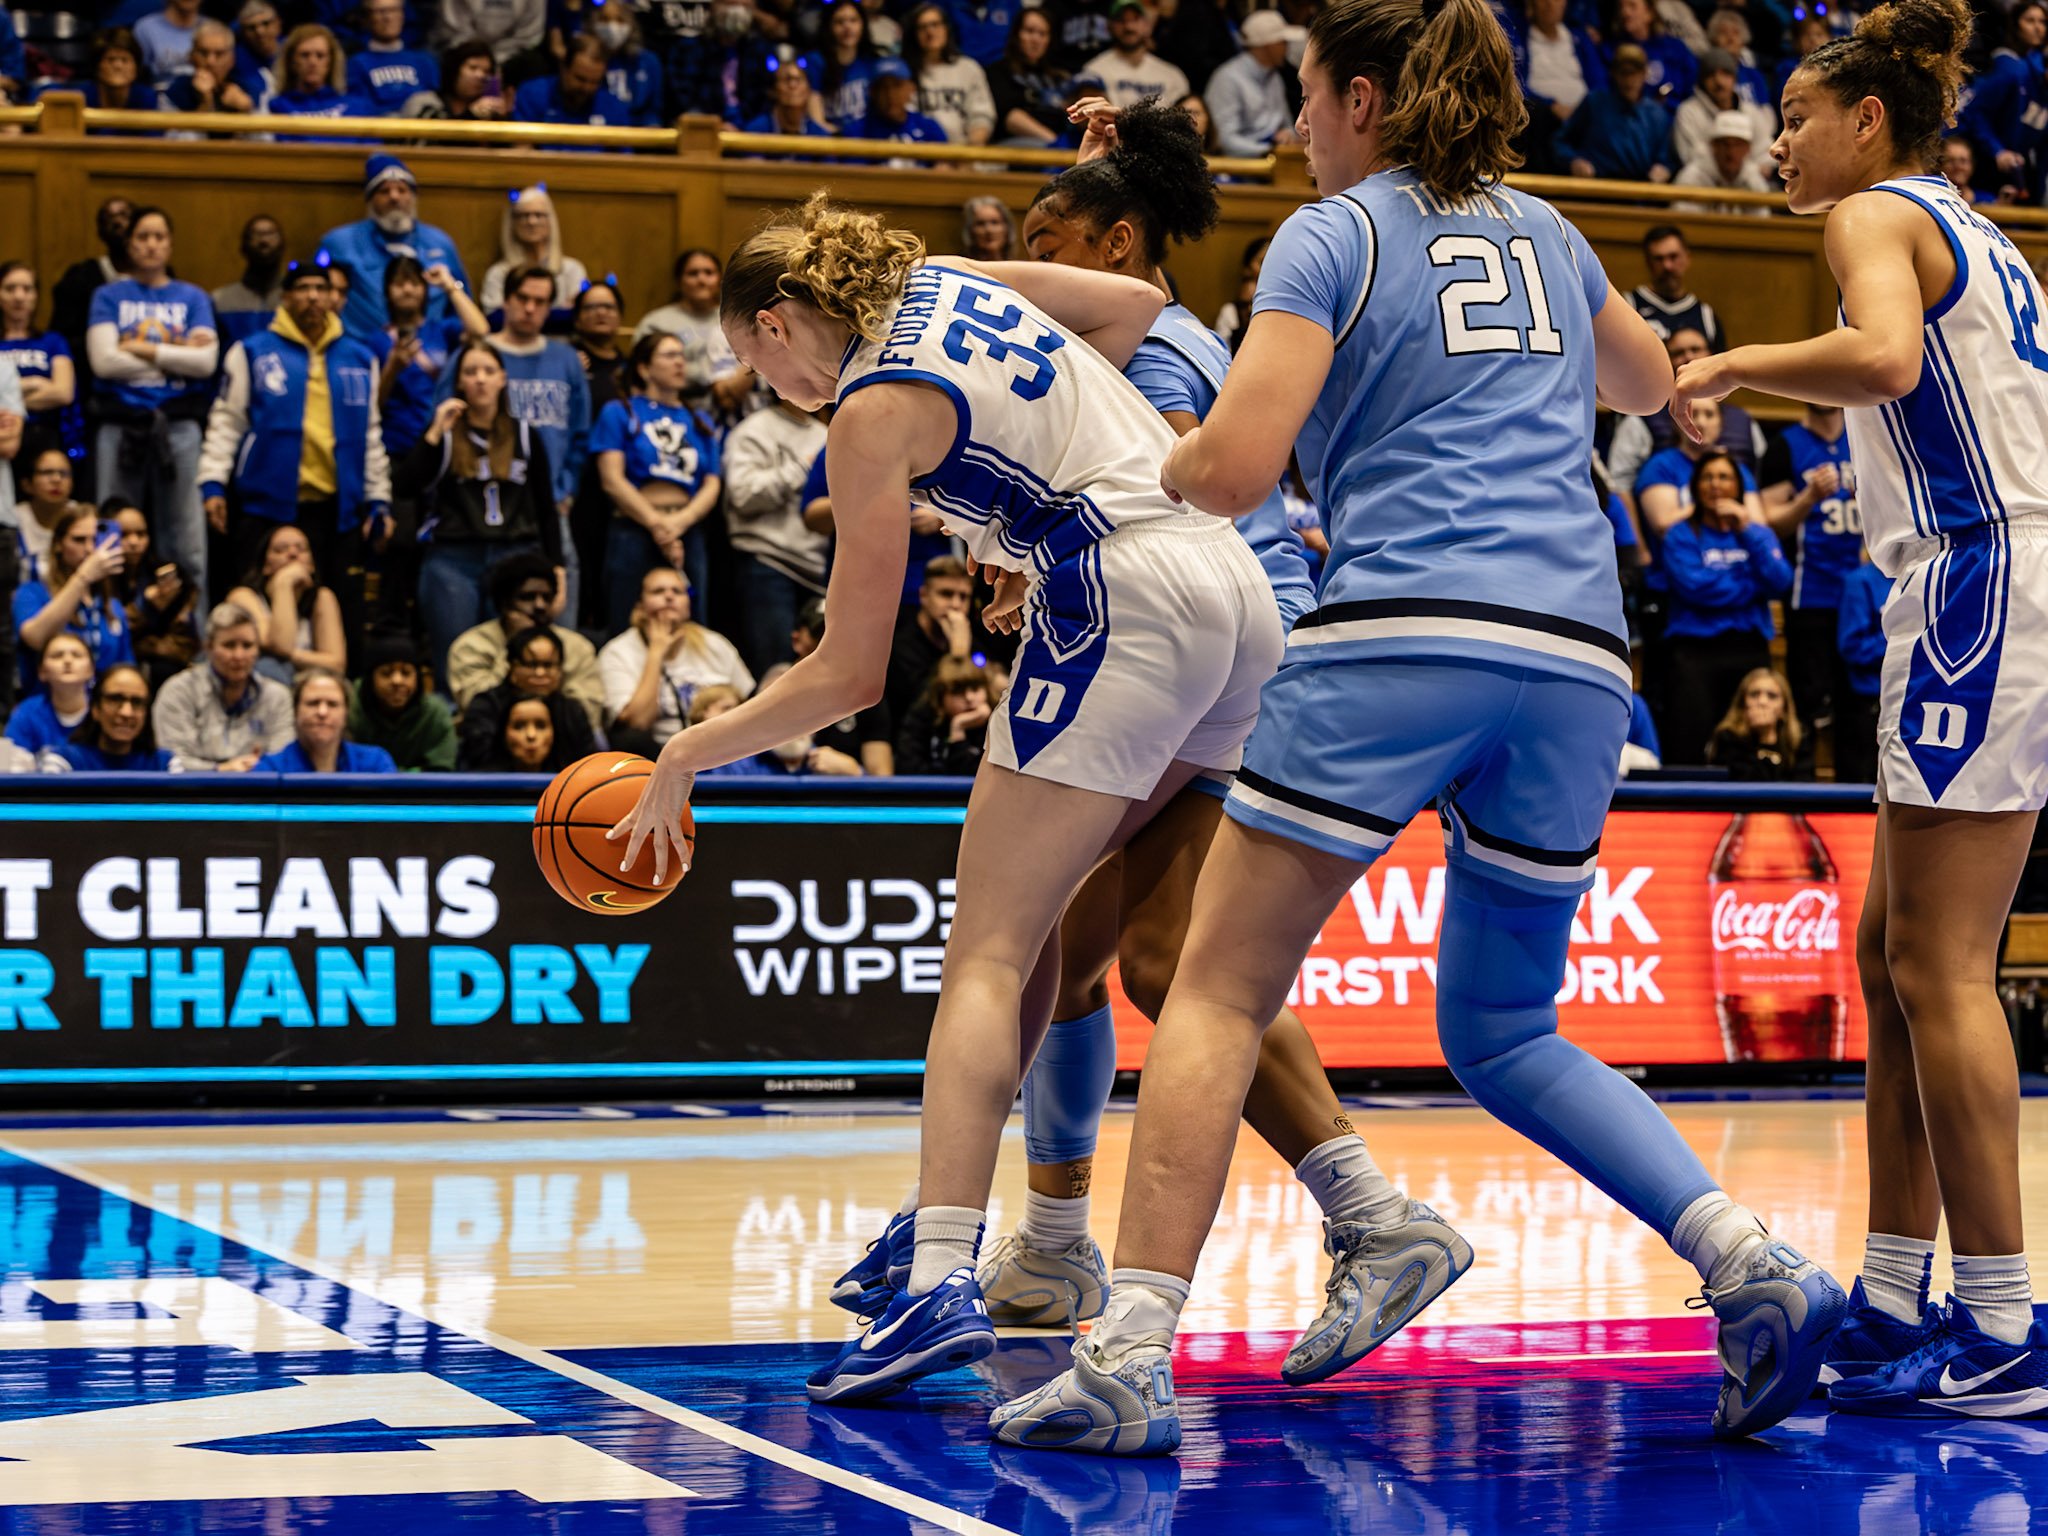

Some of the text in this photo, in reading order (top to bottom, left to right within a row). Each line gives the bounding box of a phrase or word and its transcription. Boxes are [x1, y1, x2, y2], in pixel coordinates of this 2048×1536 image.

[1426, 234, 1564, 357] 21
[1988, 247, 2048, 373] 12
[942, 284, 1066, 401] 35
[1820, 498, 1863, 535] 30
[1015, 678, 1066, 723] D
[1915, 702, 1968, 749] D
[77, 855, 500, 941] CLEANS
[1711, 889, 1840, 952] Coca-Cola
[84, 946, 397, 1030] THAN
[429, 944, 651, 1026] DRY
